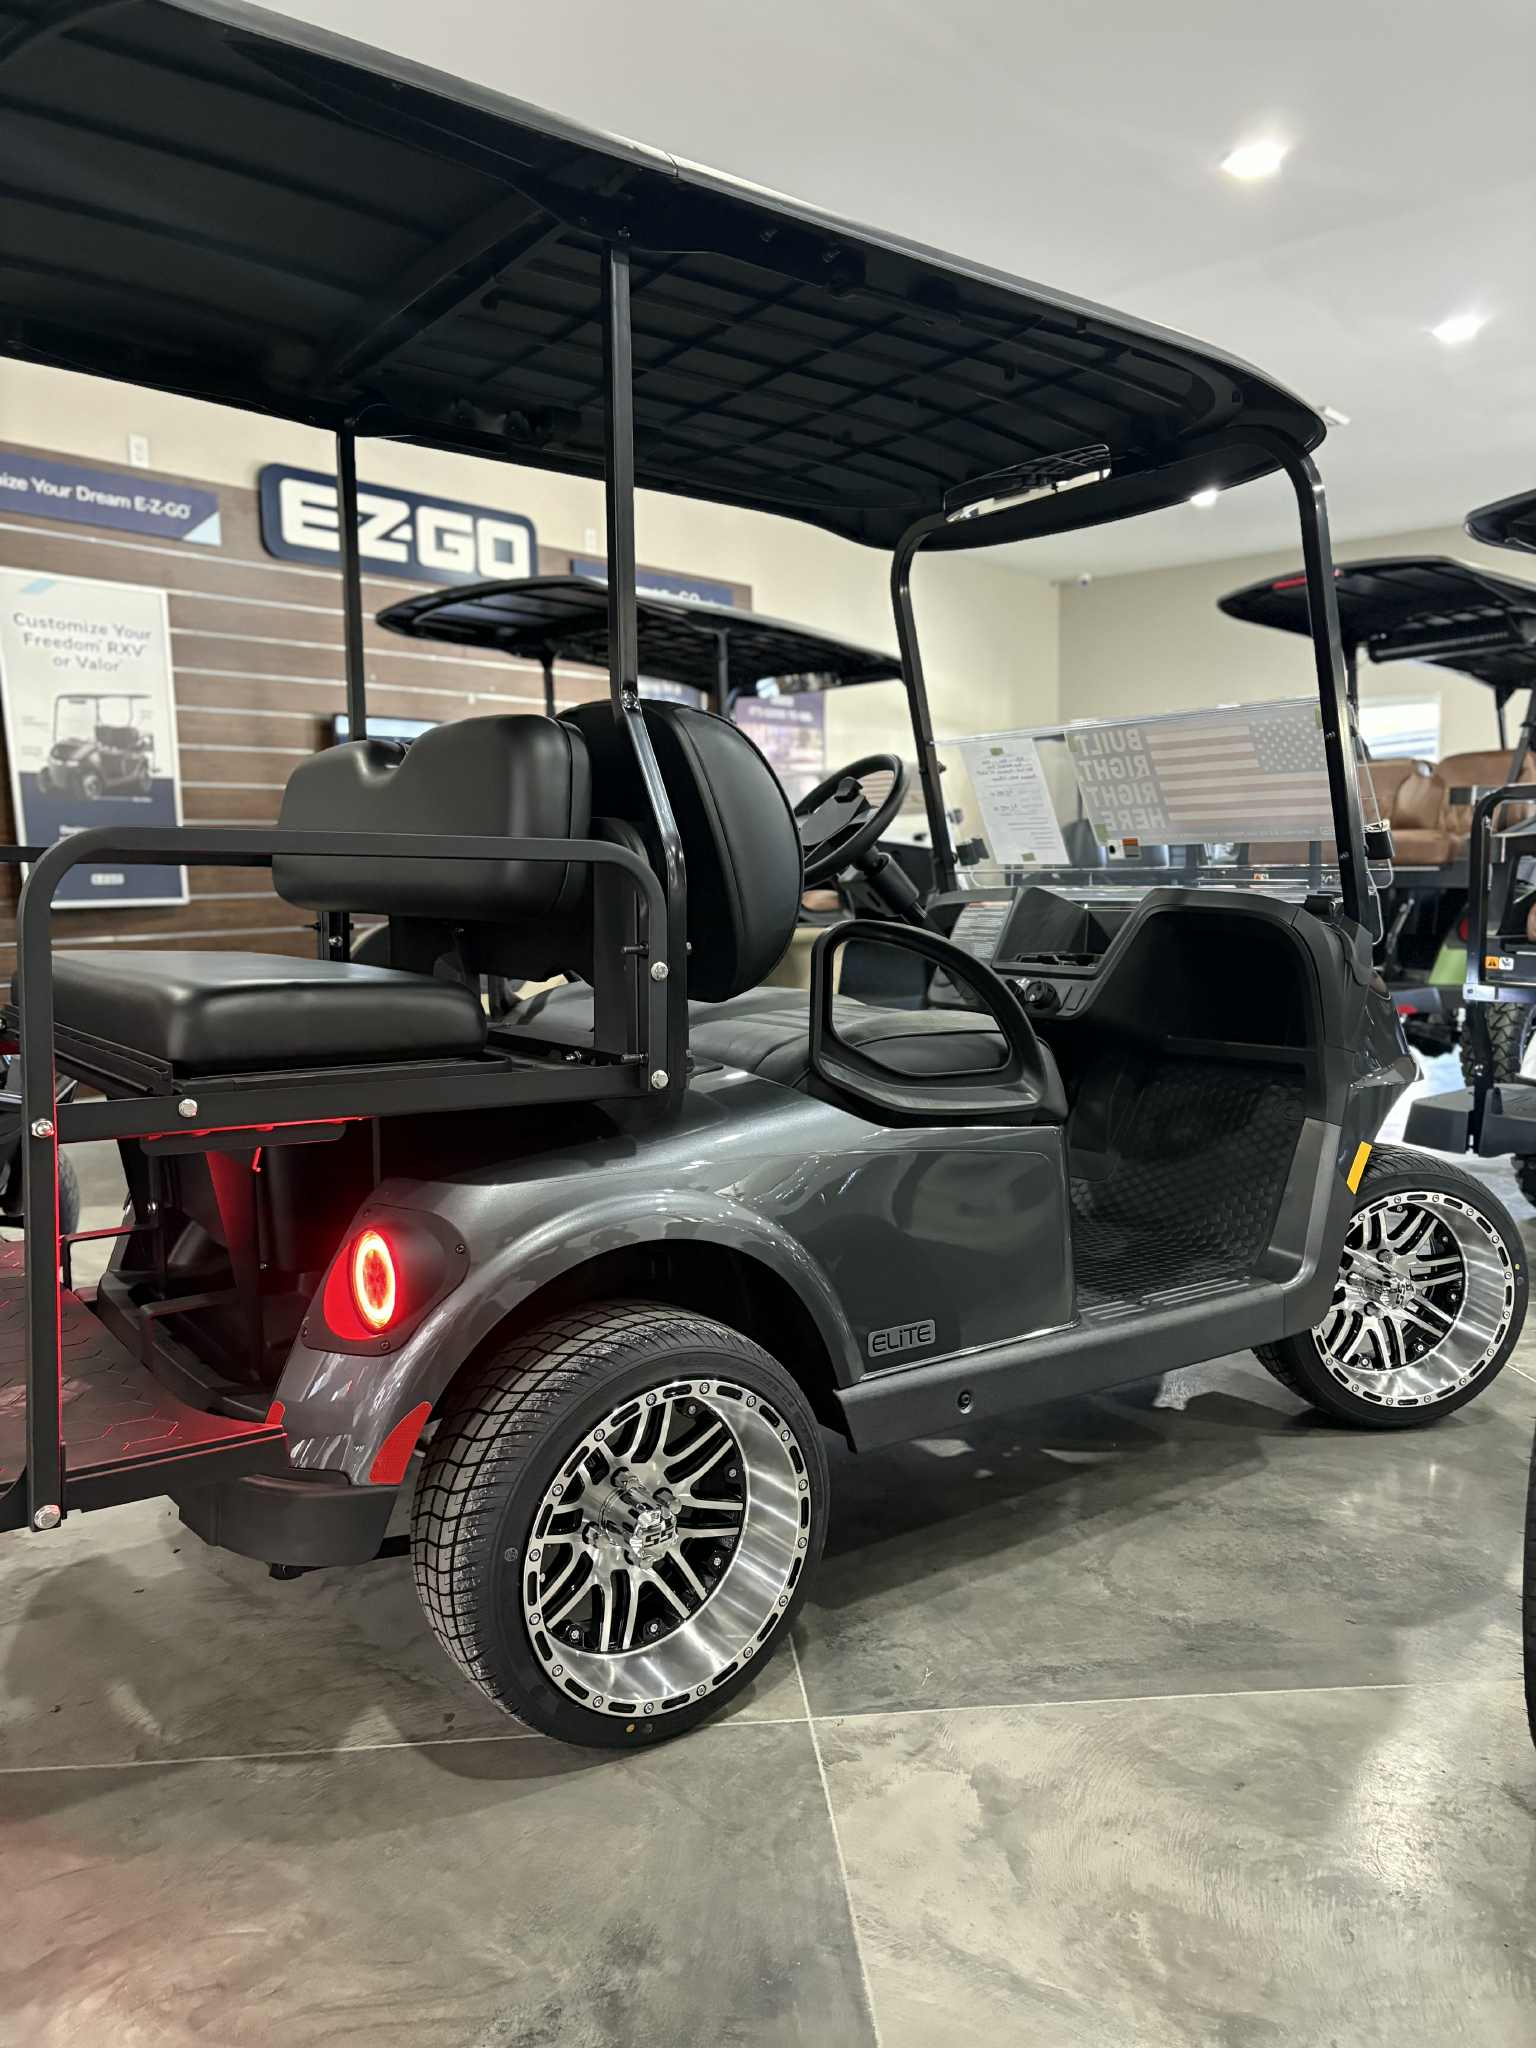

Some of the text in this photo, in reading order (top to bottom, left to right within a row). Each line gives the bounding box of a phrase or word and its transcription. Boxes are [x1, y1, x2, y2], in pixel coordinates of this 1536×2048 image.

[0, 472, 28, 491] ize
[30, 475, 73, 498] Your
[76, 483, 131, 510] Dream
[13, 611, 152, 640] Customize Your
[23, 631, 145, 658] Freedom RXV
[53, 654, 120, 672] or Valor
